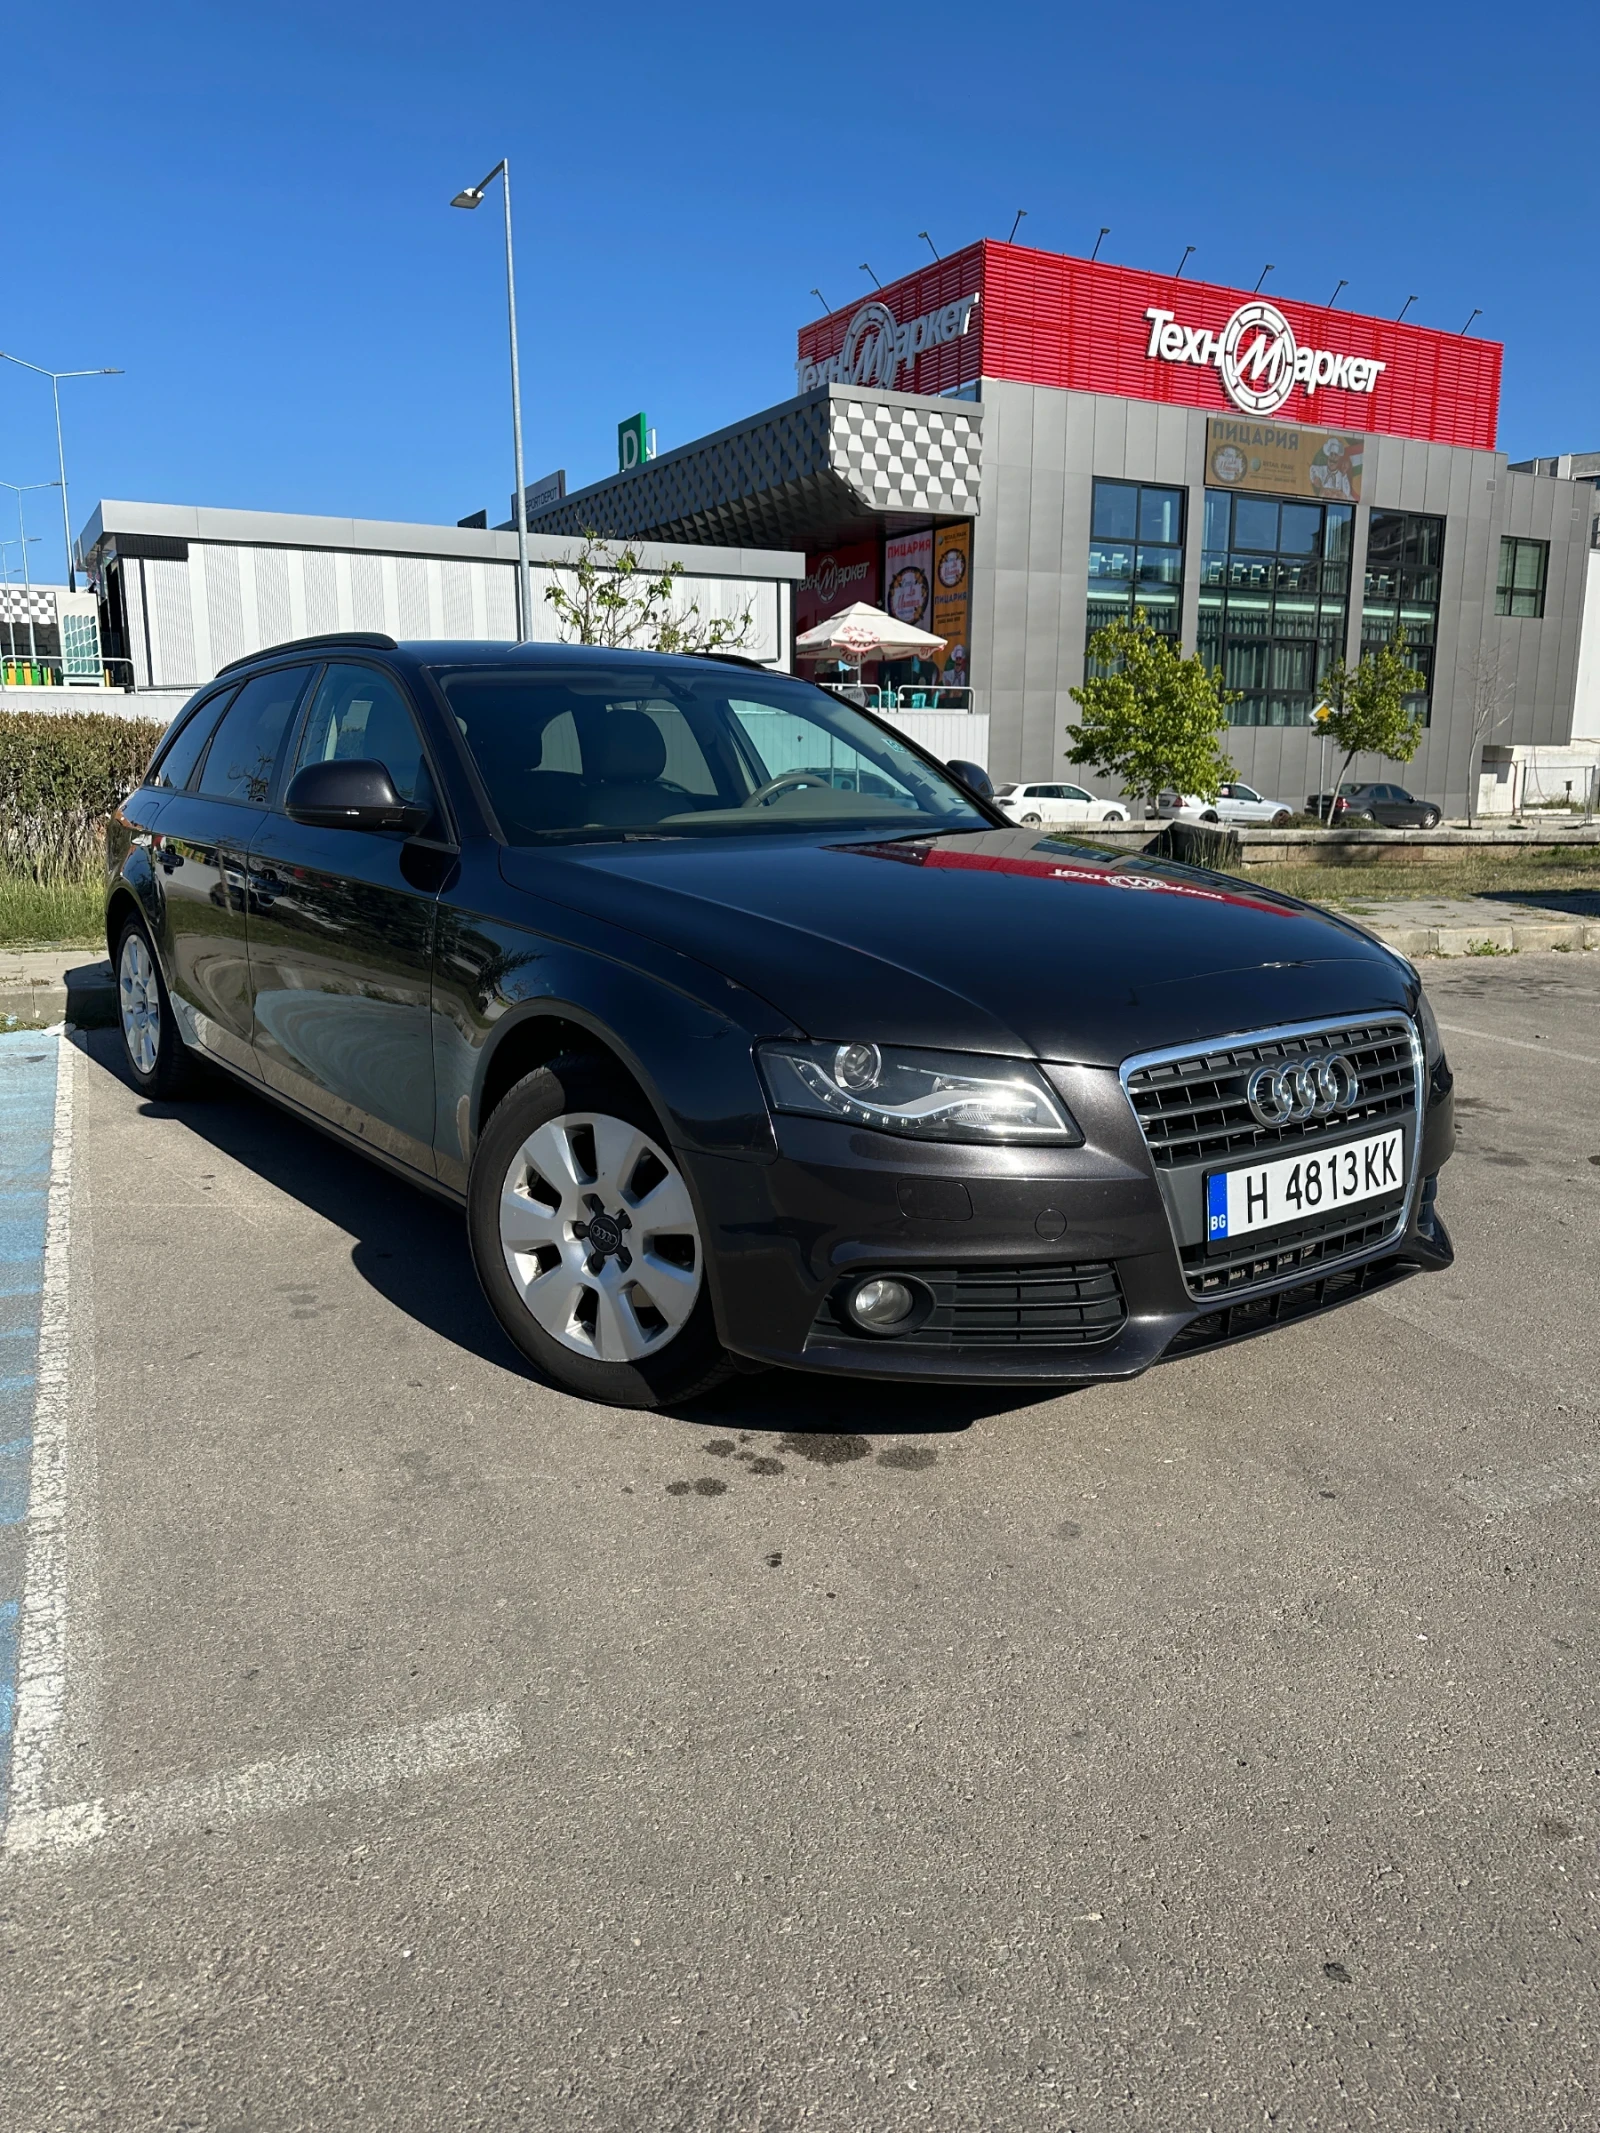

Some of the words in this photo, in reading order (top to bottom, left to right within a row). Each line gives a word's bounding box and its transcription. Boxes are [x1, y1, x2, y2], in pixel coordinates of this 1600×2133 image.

[1213, 421, 1299, 450] ПИЦАРИЯ
[887, 539, 931, 559] ПИЦАРИЯ
[935, 592, 967, 605] ПИЦАРИЯ
[1246, 1171, 1269, 1224] H
[1210, 1213, 1227, 1231] BG
